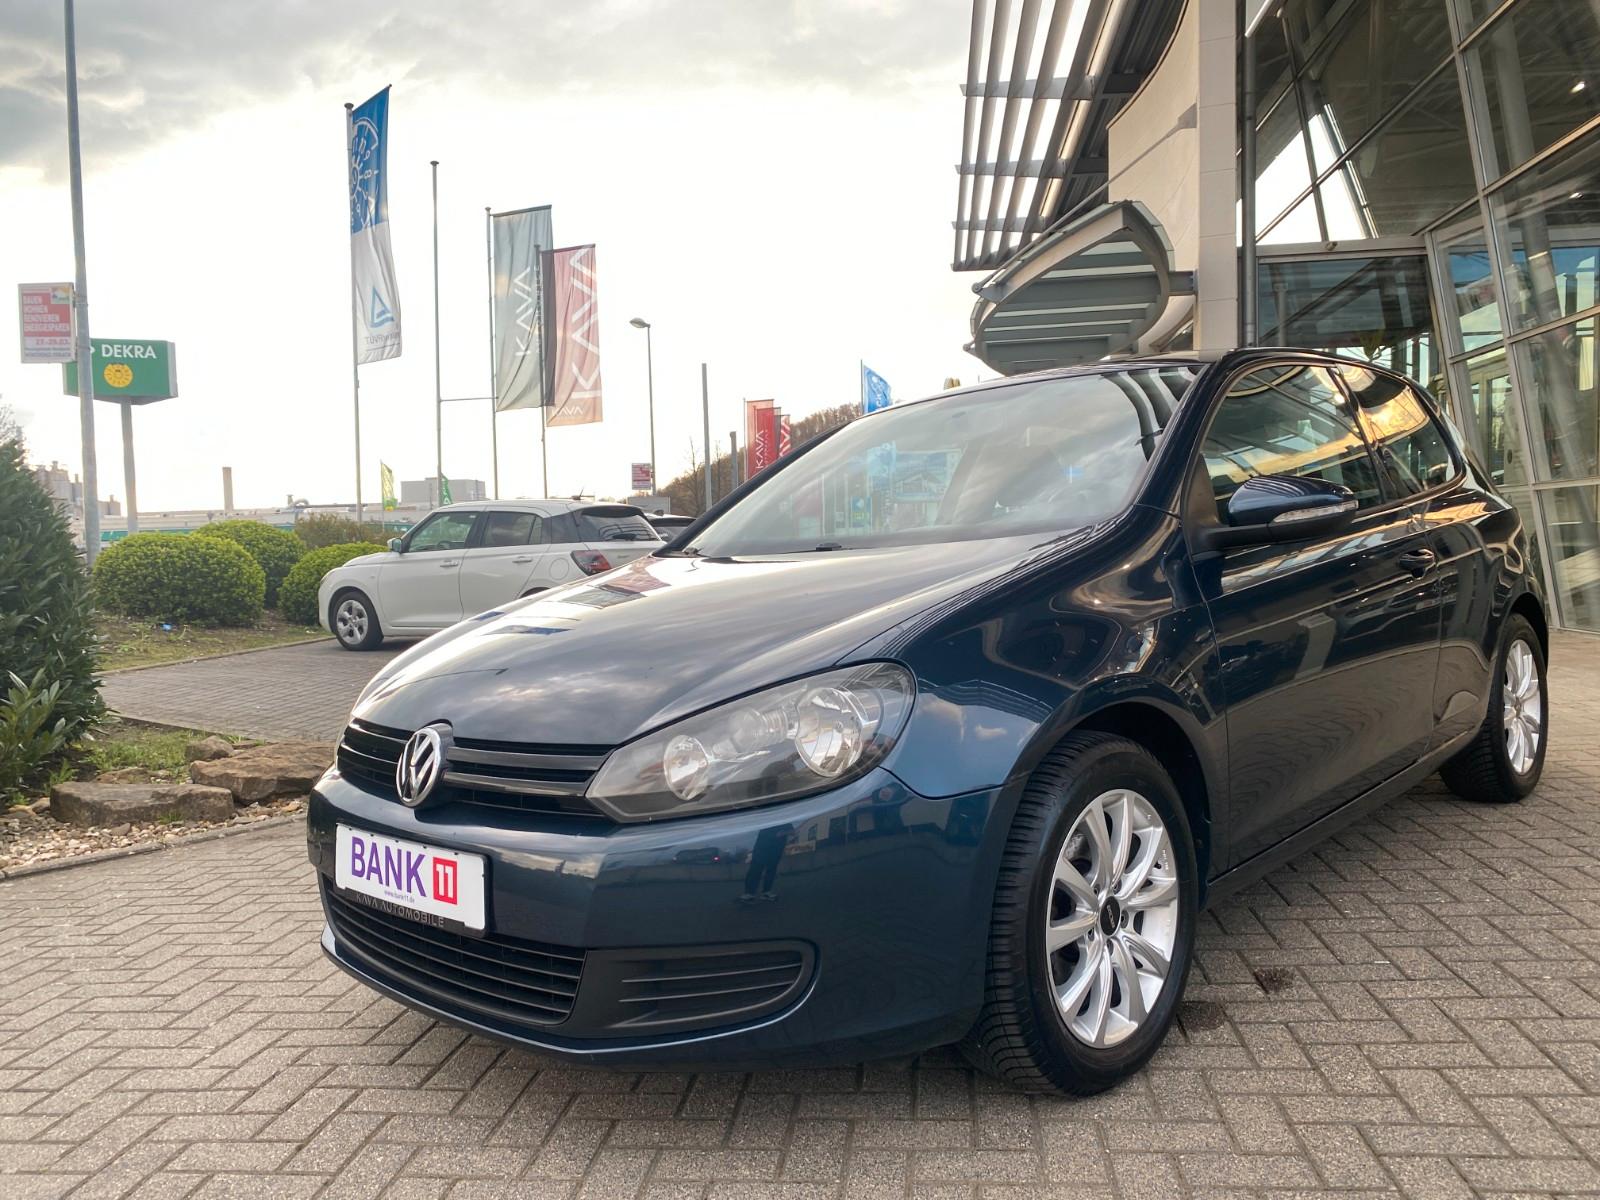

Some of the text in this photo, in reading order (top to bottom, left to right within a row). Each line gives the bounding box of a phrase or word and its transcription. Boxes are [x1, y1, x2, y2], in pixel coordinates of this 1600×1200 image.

[514, 266, 533, 356] KAVA
[570, 249, 602, 399] KAVA
[101, 344, 157, 359] DEKRA
[755, 429, 765, 469] KAVA
[351, 836, 455, 900] BANK 11
[356, 893, 445, 928] KAVA AUTOMOBILE
